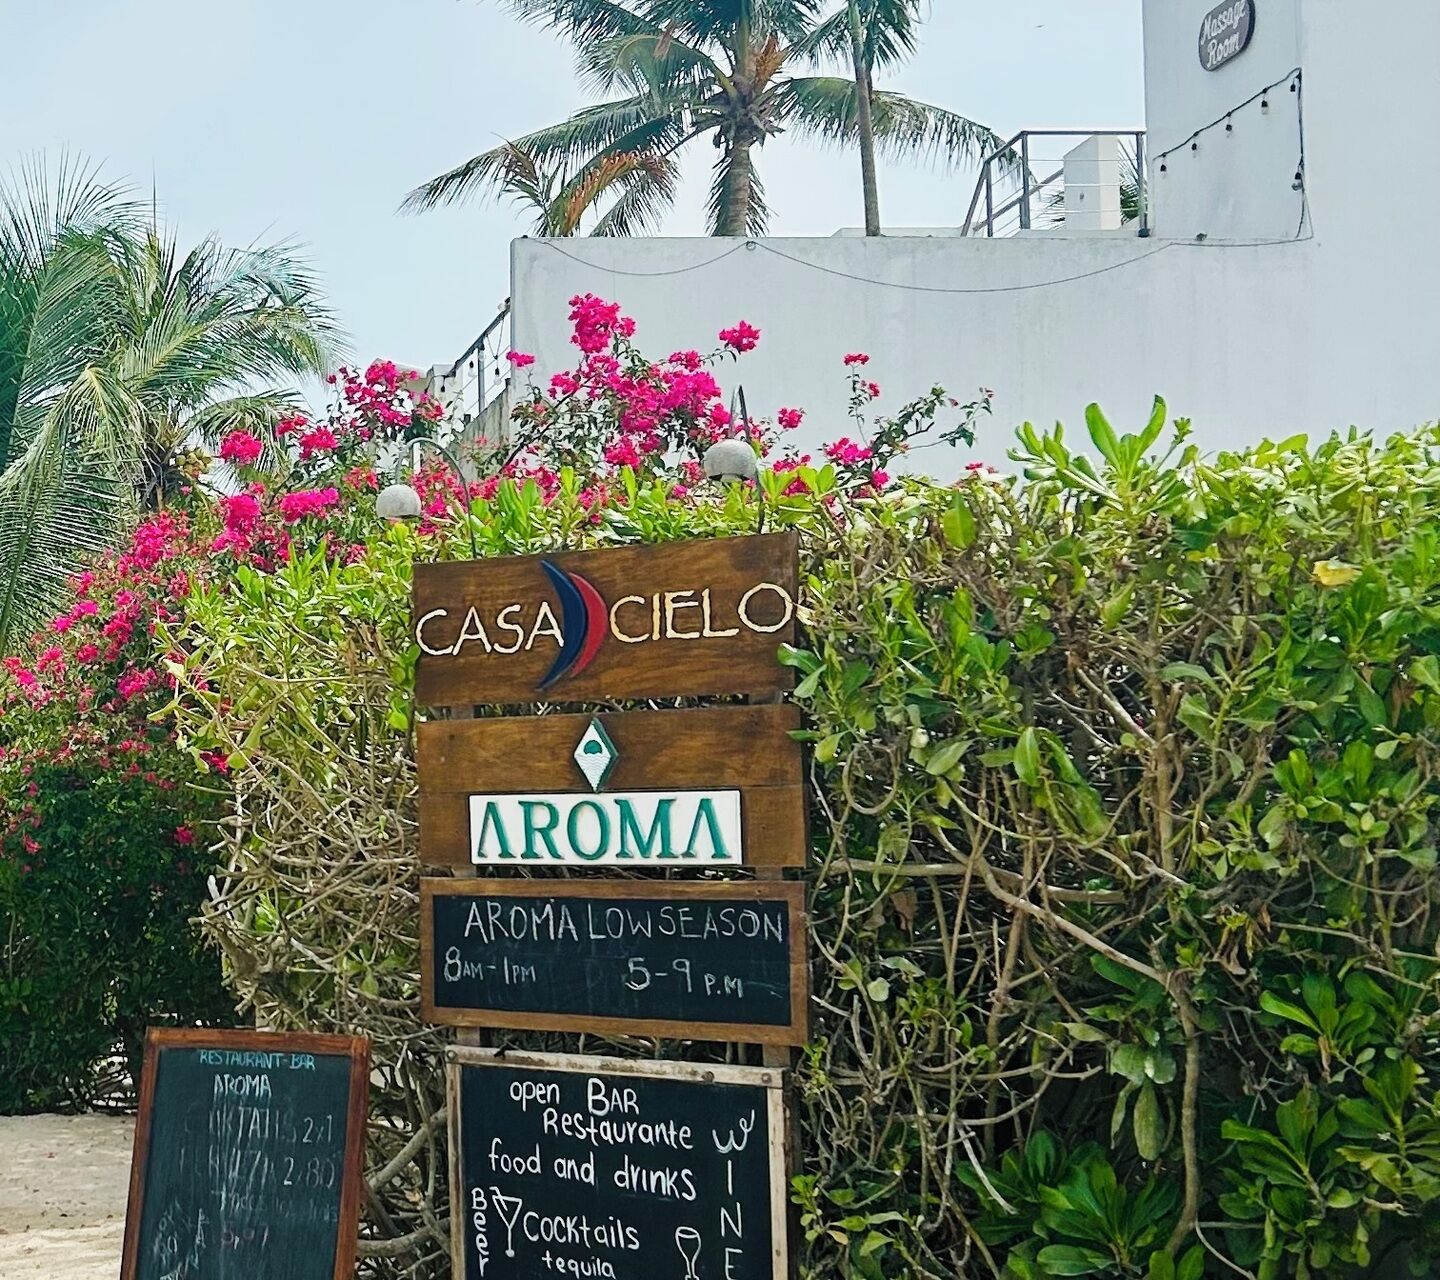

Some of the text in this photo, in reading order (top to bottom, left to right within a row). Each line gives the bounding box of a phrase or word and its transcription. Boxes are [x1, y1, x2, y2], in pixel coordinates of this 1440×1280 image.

[1207, 32, 1240, 68] Room
[415, 582, 794, 656] CASA CIELO
[477, 797, 732, 861] AROMA
[464, 899, 784, 944] AROMA LOW SEASON
[213, 1074, 272, 1097] AROMA
[509, 1078, 639, 1116] open BAR
[302, 1114, 333, 1144] 2x1
[543, 1107, 694, 1150] Restaurante
[488, 1138, 697, 1201] food and drinks
[542, 1251, 617, 1280] tequila
